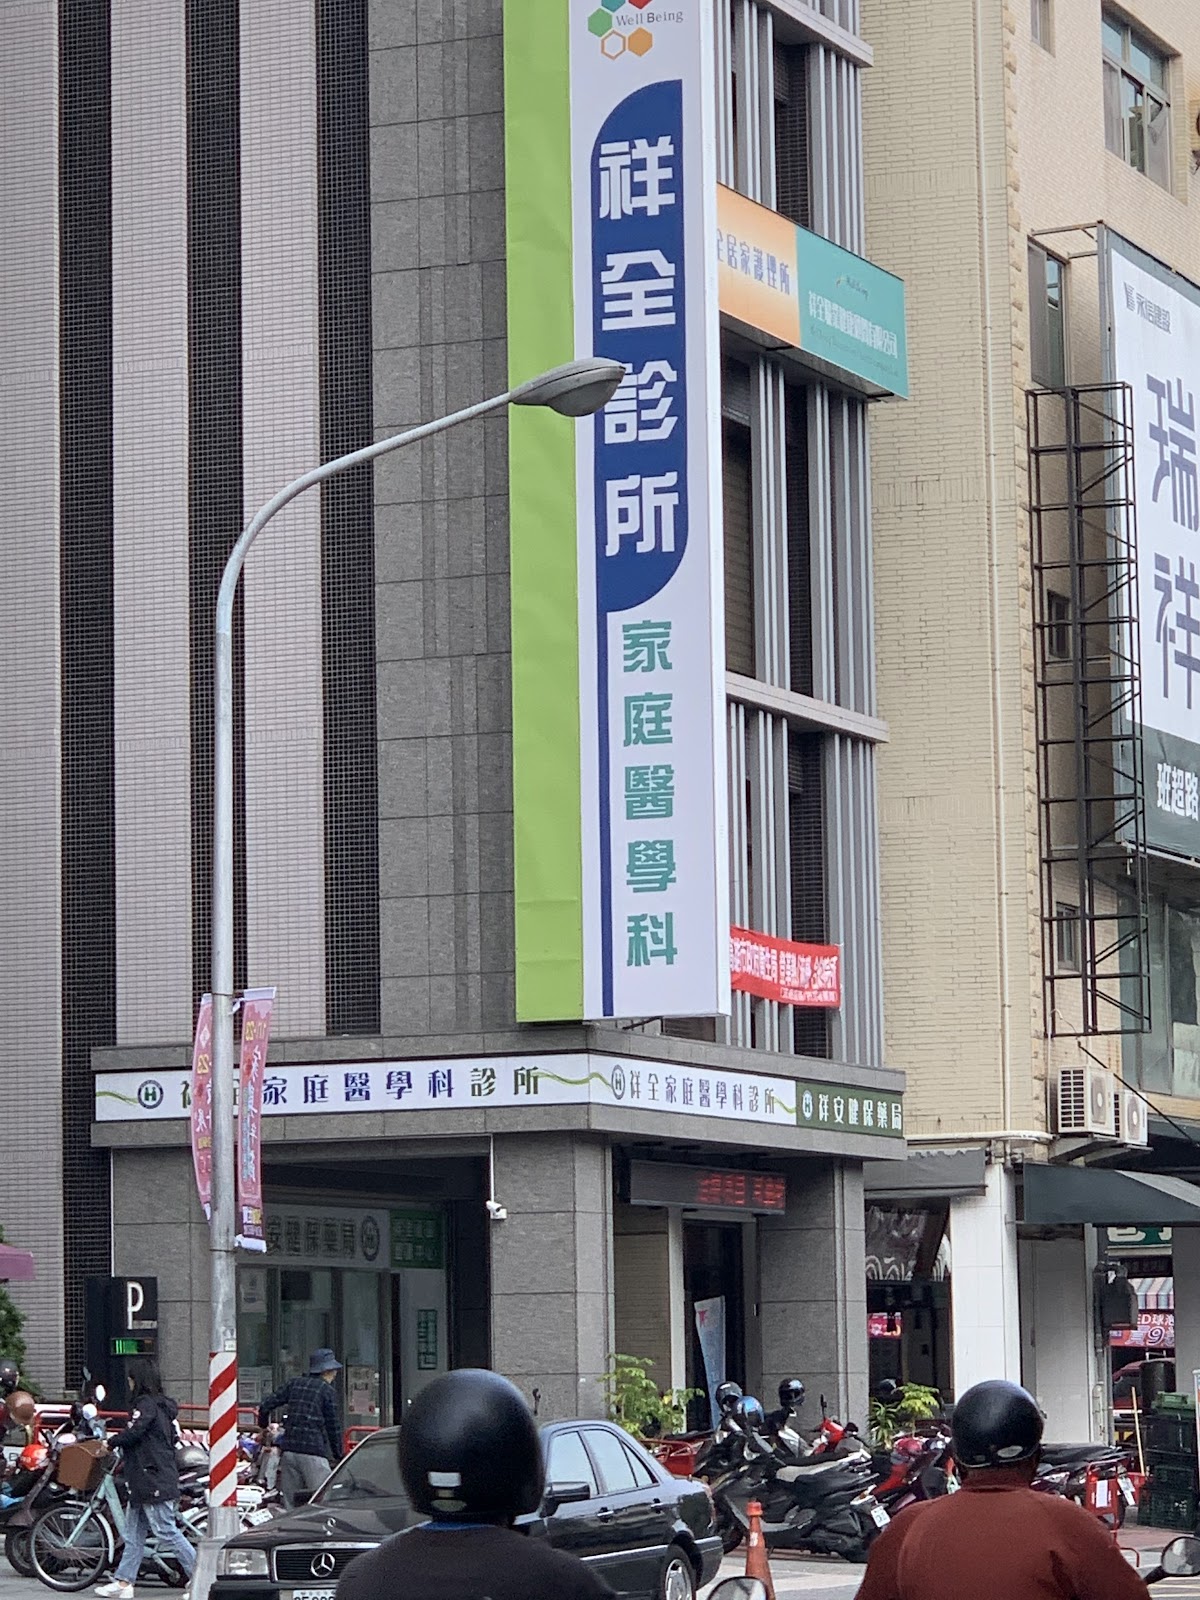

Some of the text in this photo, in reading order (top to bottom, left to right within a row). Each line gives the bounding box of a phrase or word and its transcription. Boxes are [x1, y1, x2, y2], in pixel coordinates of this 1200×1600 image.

[616, 10, 684, 26] Well Being
[599, 135, 678, 556] 祥全診所
[622, 620, 677, 966] 家庭醫學科
[629, 1069, 775, 1115] 祥全家庭醫學科診所
[818, 1093, 902, 1131] 祥安健保藥局
[127, 1281, 144, 1330] P
